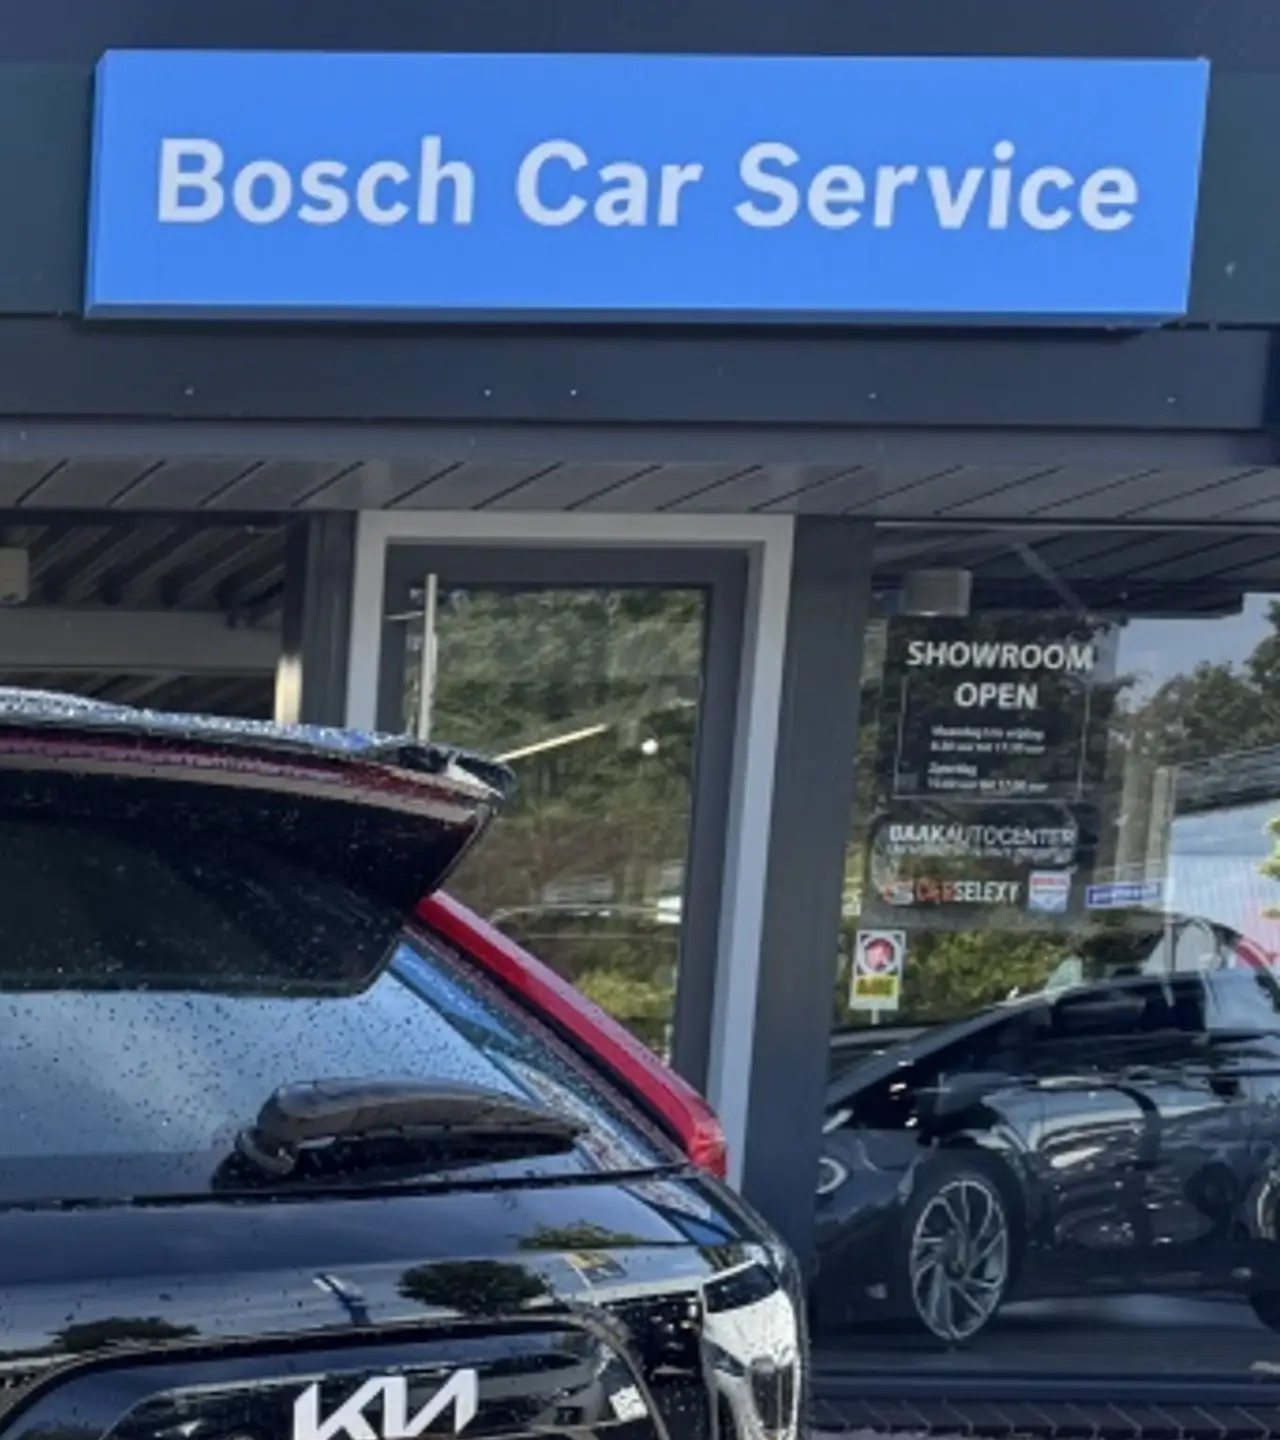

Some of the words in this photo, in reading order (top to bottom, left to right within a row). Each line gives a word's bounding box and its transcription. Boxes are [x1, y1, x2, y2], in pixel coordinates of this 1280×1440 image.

[155, 136, 473, 226] Bosch
[515, 140, 702, 227] Car
[734, 140, 1139, 232] Service
[906, 640, 1094, 671] SHOWROOM
[954, 681, 1038, 710] OPEN
